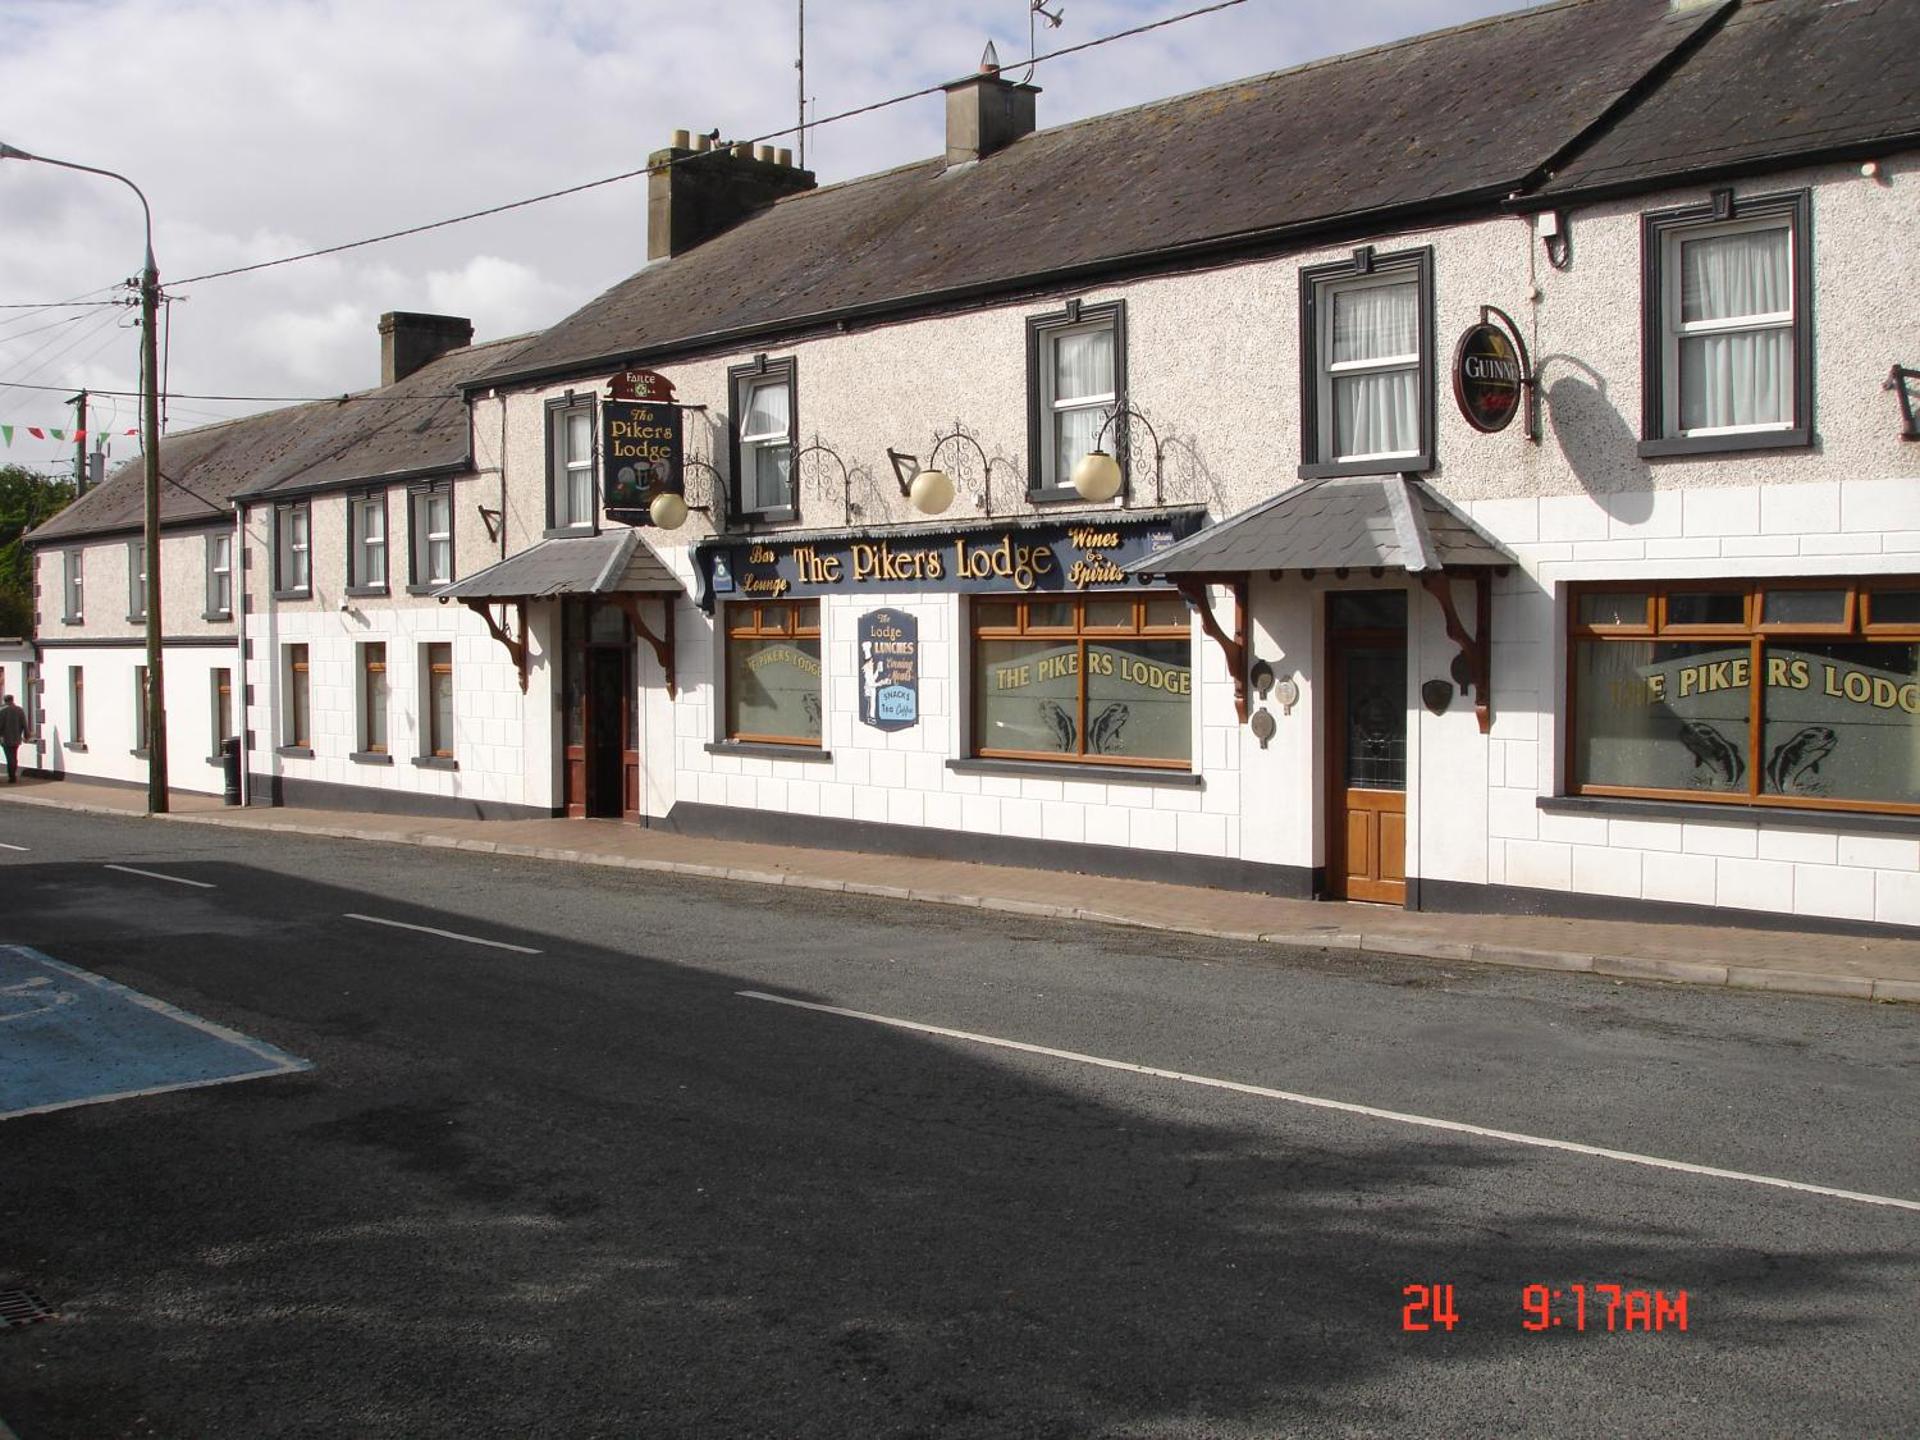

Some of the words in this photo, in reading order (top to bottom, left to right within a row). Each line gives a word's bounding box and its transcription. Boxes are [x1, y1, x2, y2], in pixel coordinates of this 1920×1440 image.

[612, 421, 673, 440] Pikers
[614, 440, 672, 463] Lodge
[1068, 527, 1120, 548] Wines
[749, 544, 775, 564] Bar
[793, 546, 840, 582] The
[851, 540, 942, 581] Pikers
[955, 534, 1053, 590] Lodge
[744, 572, 788, 598] Lounge
[1067, 560, 1125, 590] Spirits
[871, 625, 903, 641] Lodge
[875, 641, 914, 654] LUNCHES
[996, 665, 1030, 690] THE
[1038, 652, 1113, 682] PIKERS
[1120, 656, 1191, 696] LODGE
[1678, 657, 1810, 698] PIKERS
